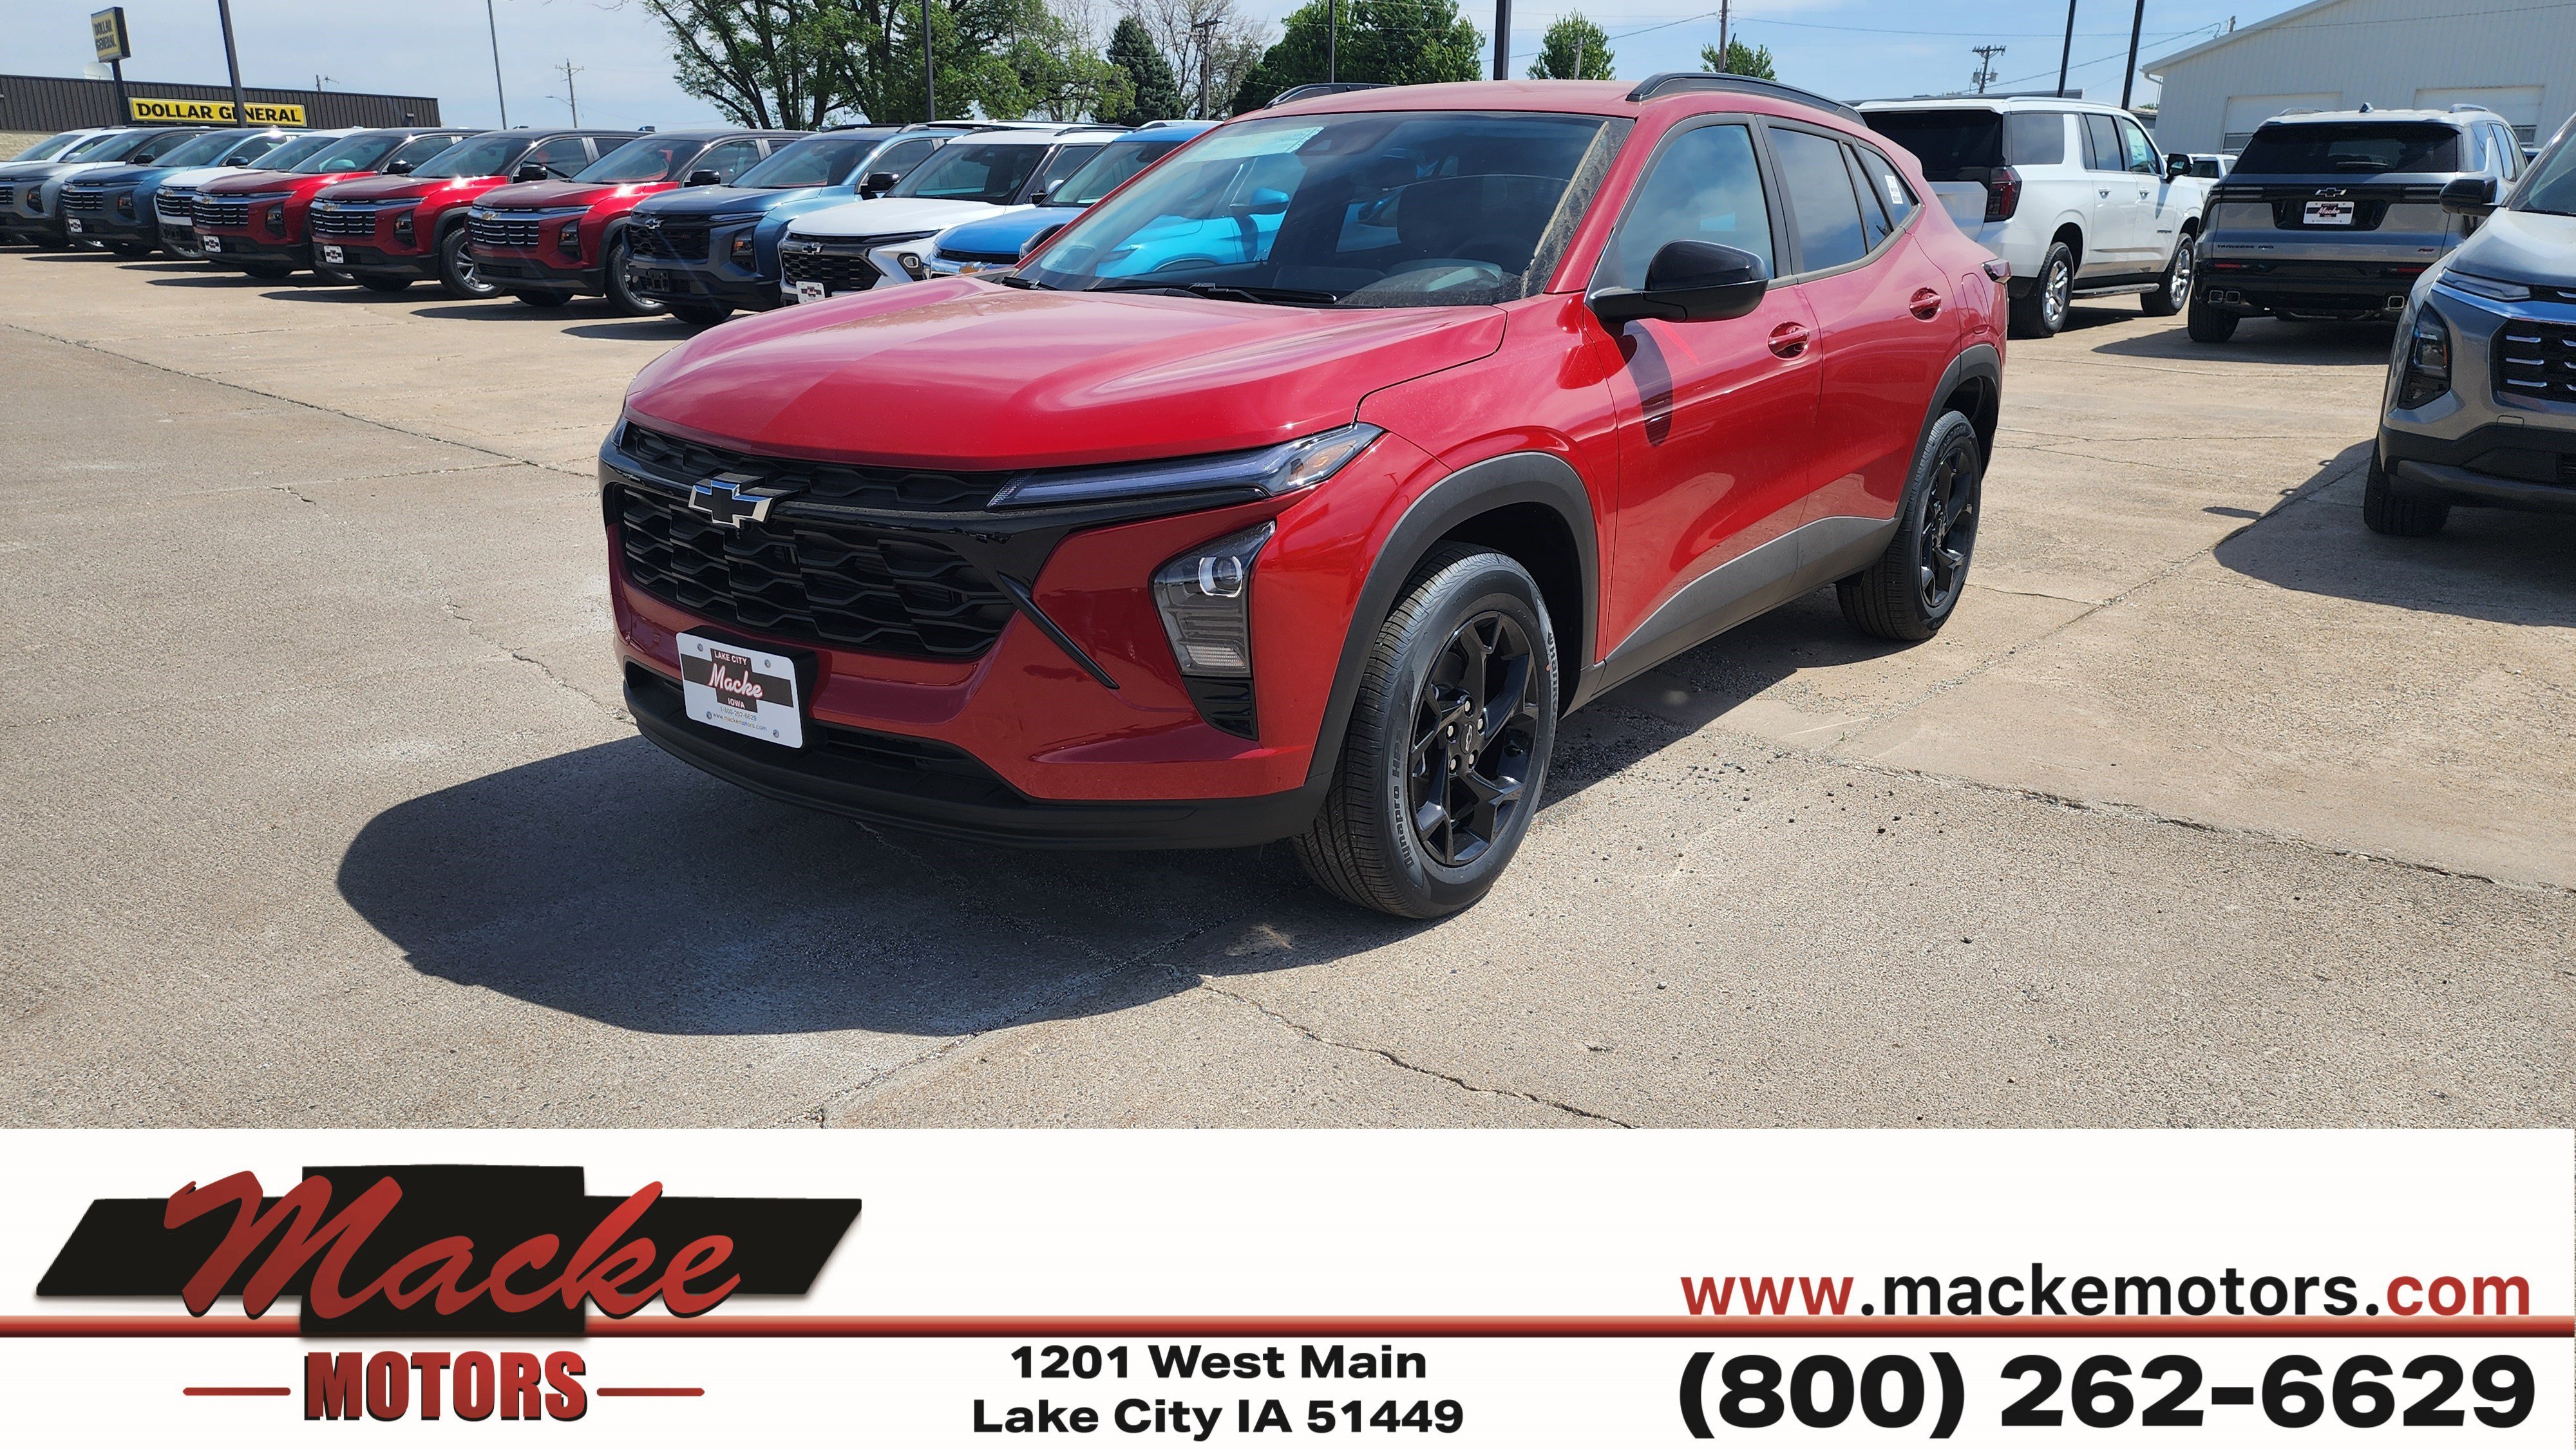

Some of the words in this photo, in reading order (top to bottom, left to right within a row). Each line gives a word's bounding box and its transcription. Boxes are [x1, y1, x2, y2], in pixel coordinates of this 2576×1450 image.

[136, 102, 213, 118] DOLLAR
[714, 650, 731, 662] LAKE
[731, 655, 748, 666] CITY
[708, 663, 763, 698] Macke
[727, 697, 746, 709] IOWA
[1392, 786, 1414, 869] Dynapro
